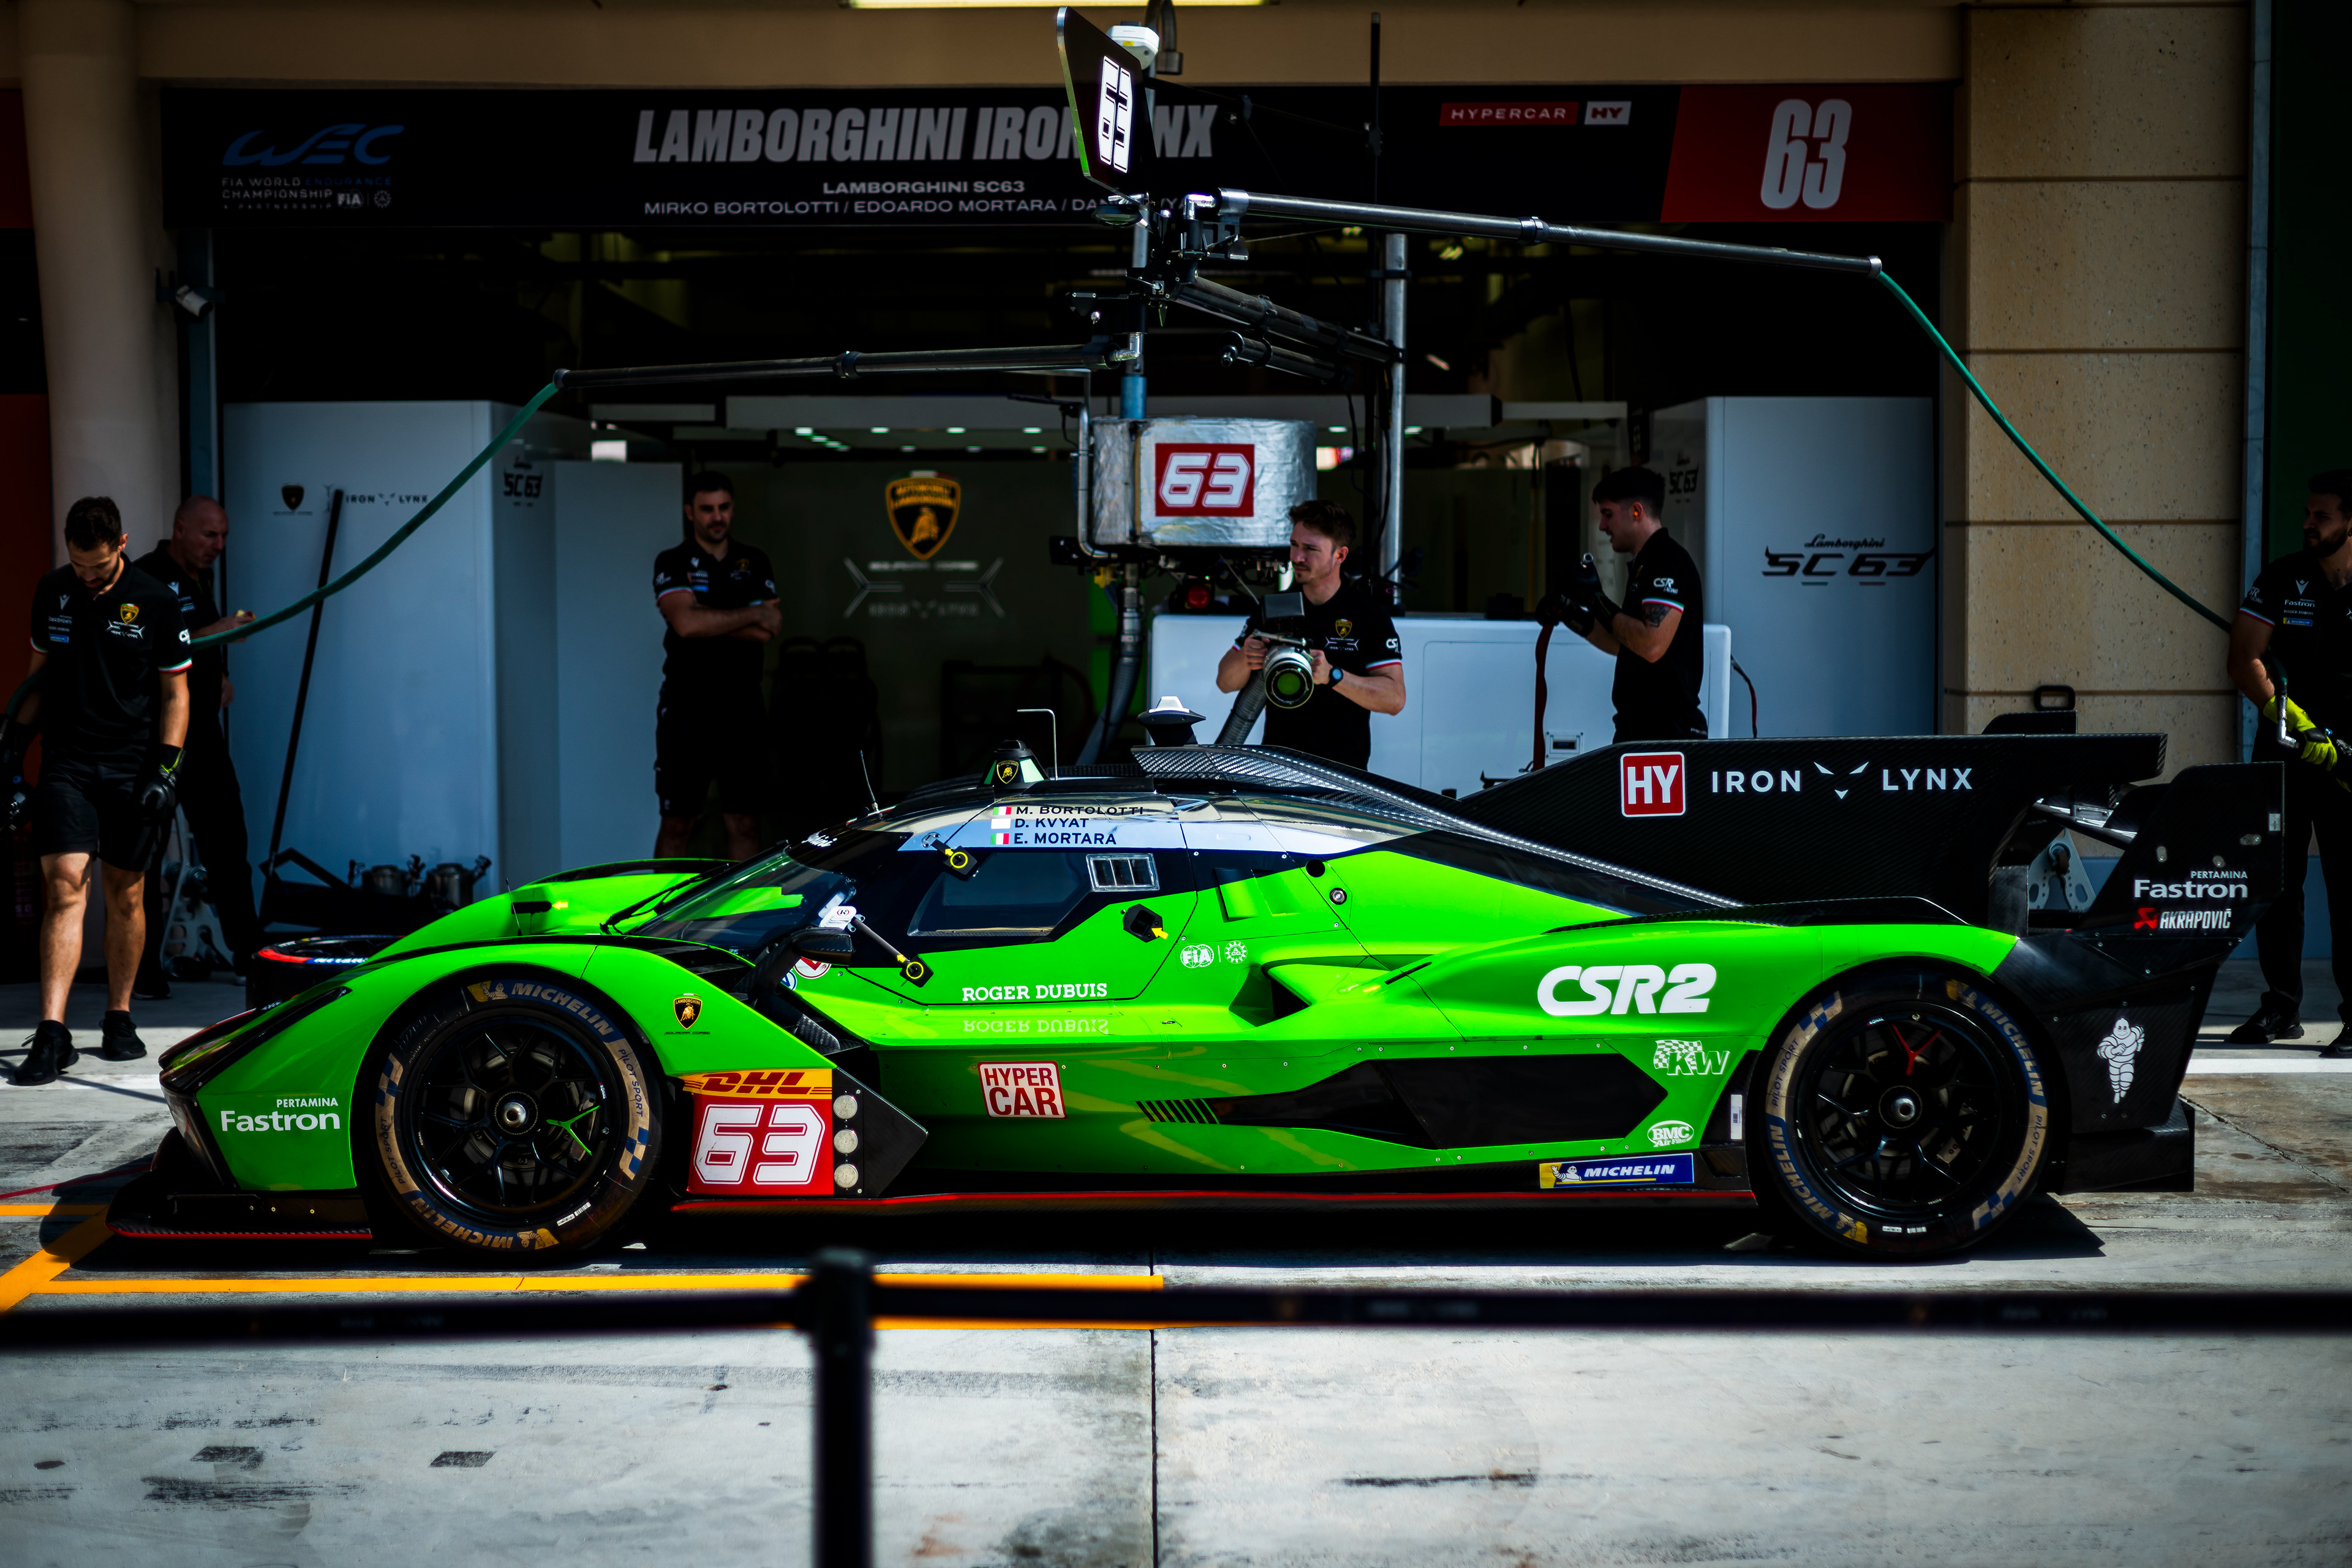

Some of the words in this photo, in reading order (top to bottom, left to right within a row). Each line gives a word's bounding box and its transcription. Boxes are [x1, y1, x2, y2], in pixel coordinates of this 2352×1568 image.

[1098, 55, 1133, 173] 63
[1450, 107, 1567, 120] HYPERCAR
[1591, 107, 1623, 119] HY
[222, 123, 405, 167] WEC
[633, 107, 967, 162] LAMBORGHINI
[1760, 99, 1853, 209] 63
[222, 177, 244, 187] FIA
[249, 177, 301, 187] WORLD
[306, 176, 393, 186] ENDURANCE
[222, 189, 333, 199] CHAMPIONSHIP
[823, 181, 968, 194] LAMBORGHINI
[973, 181, 1026, 193] SC63
[644, 201, 709, 215] MIRKO
[714, 201, 839, 214] BORTOLOTTI
[854, 200, 952, 213] EDOARDO
[959, 199, 1058, 213] MORTARA
[1159, 453, 1252, 508] 63
[346, 495, 375, 503] IRON
[399, 495, 428, 503] LYNX
[1804, 533, 1886, 551] Lamborghini
[2248, 586, 2261, 597] SR
[2284, 599, 2315, 608] Fastron
[1627, 765, 1679, 804] HY
[1713, 770, 1801, 793] IRON
[1883, 767, 1972, 791] LYNX
[1015, 818, 1029, 827] D.
[1036, 818, 1089, 827] KVYAT
[1041, 806, 1143, 815] BORTOLOTTI
[1014, 832, 1028, 844] E.
[1034, 832, 1117, 845] MORTARA
[2134, 879, 2248, 898] Fastron
[962, 986, 1030, 1001] ROGER
[1036, 983, 1107, 998] DUBUIS
[1537, 963, 1716, 1016] CSR2
[511, 982, 614, 1036] MICHELIN
[1980, 1001, 2045, 1097] MICHELIN
[1667, 1050, 1730, 1076] KW
[1772, 1074, 1783, 1106] PILOT
[1779, 1038, 1800, 1073] SPORT
[618, 1049, 636, 1079] PILOT
[631, 1080, 643, 1117] SPORT
[702, 1072, 812, 1095] DHL
[984, 1068, 1054, 1087] HYPER
[276, 1098, 338, 1107] PERTAMINA
[989, 1087, 1060, 1116] CAR
[221, 1110, 341, 1131] Fastron
[1652, 1126, 1690, 1140] BMC
[2031, 1115, 2043, 1148] PILOT
[380, 1116, 393, 1153] SPORT
[693, 1104, 825, 1185] 63
[387, 1156, 405, 1185] PILOT
[1584, 1164, 1675, 1178] MICHELIN
[1770, 1124, 1835, 1221] MICHELIN
[2016, 1149, 2035, 1184] SPORT
[410, 1197, 514, 1249] MICHELIN
